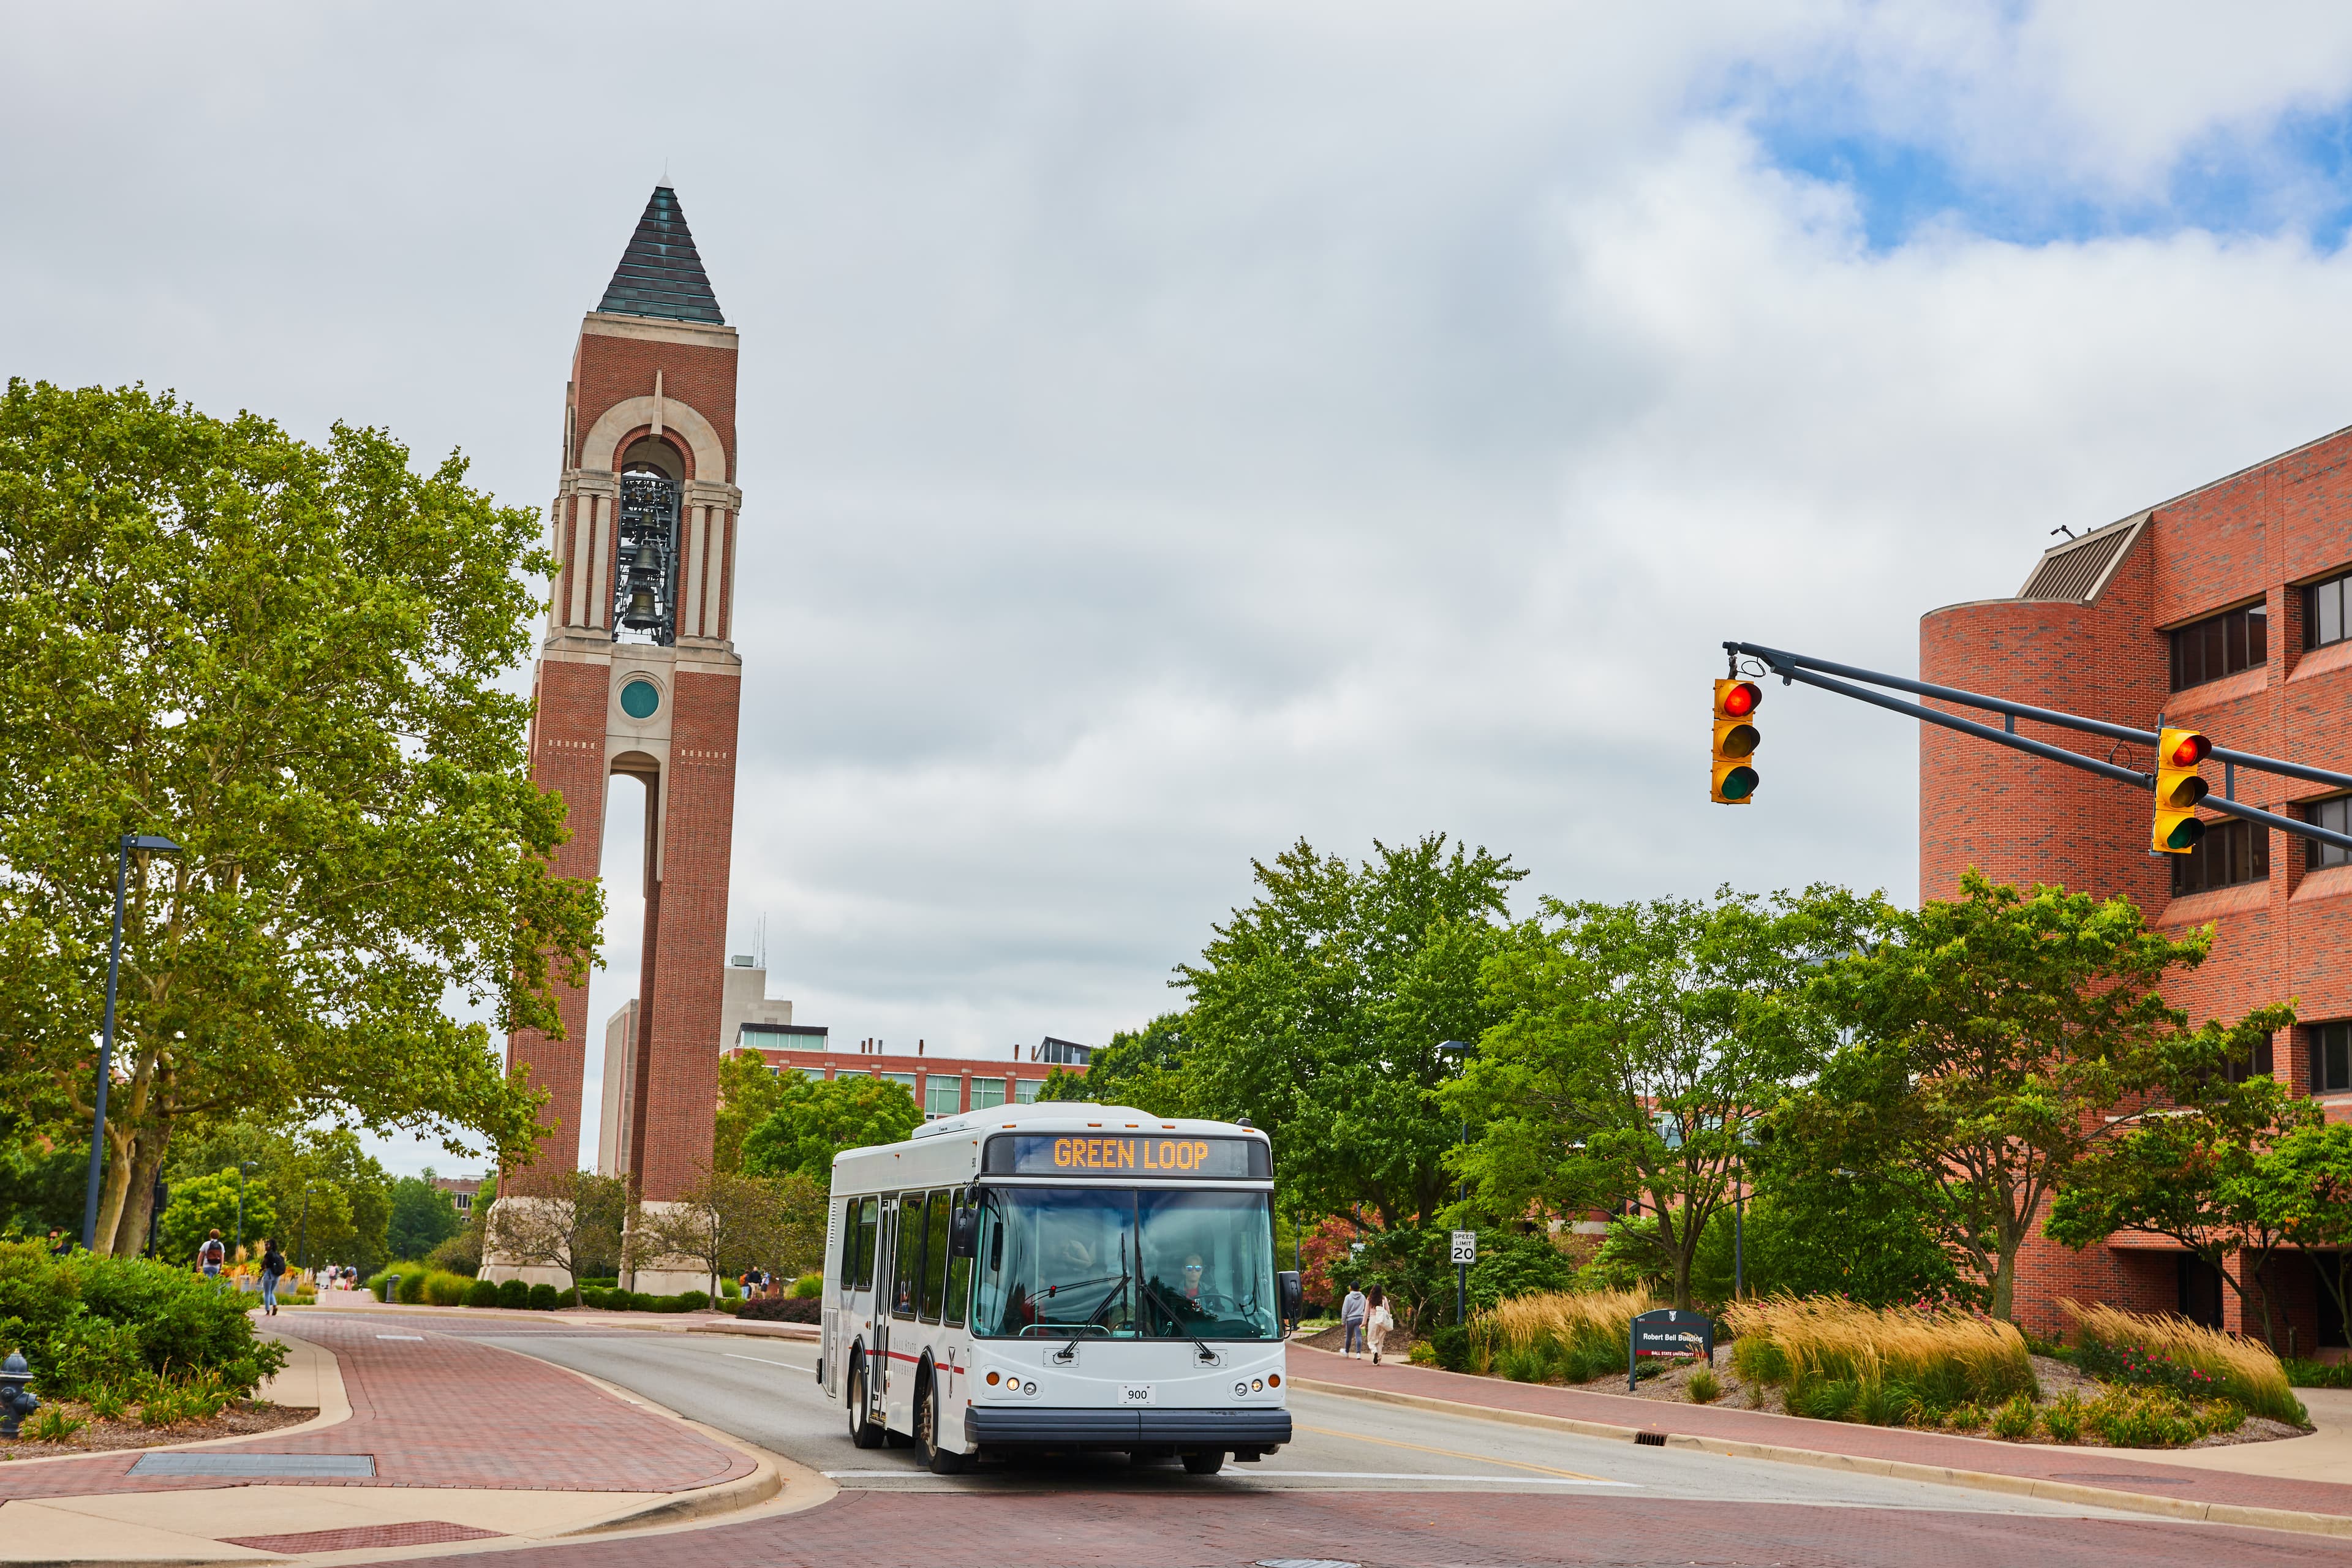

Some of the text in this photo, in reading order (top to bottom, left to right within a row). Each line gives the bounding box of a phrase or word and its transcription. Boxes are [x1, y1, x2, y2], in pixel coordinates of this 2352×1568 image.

[1054, 1139, 1208, 1169] GREEN LOOP
[1453, 1247, 1474, 1260] 20
[1678, 1334, 1703, 1343] Building
[1128, 1390, 1147, 1399] 900
